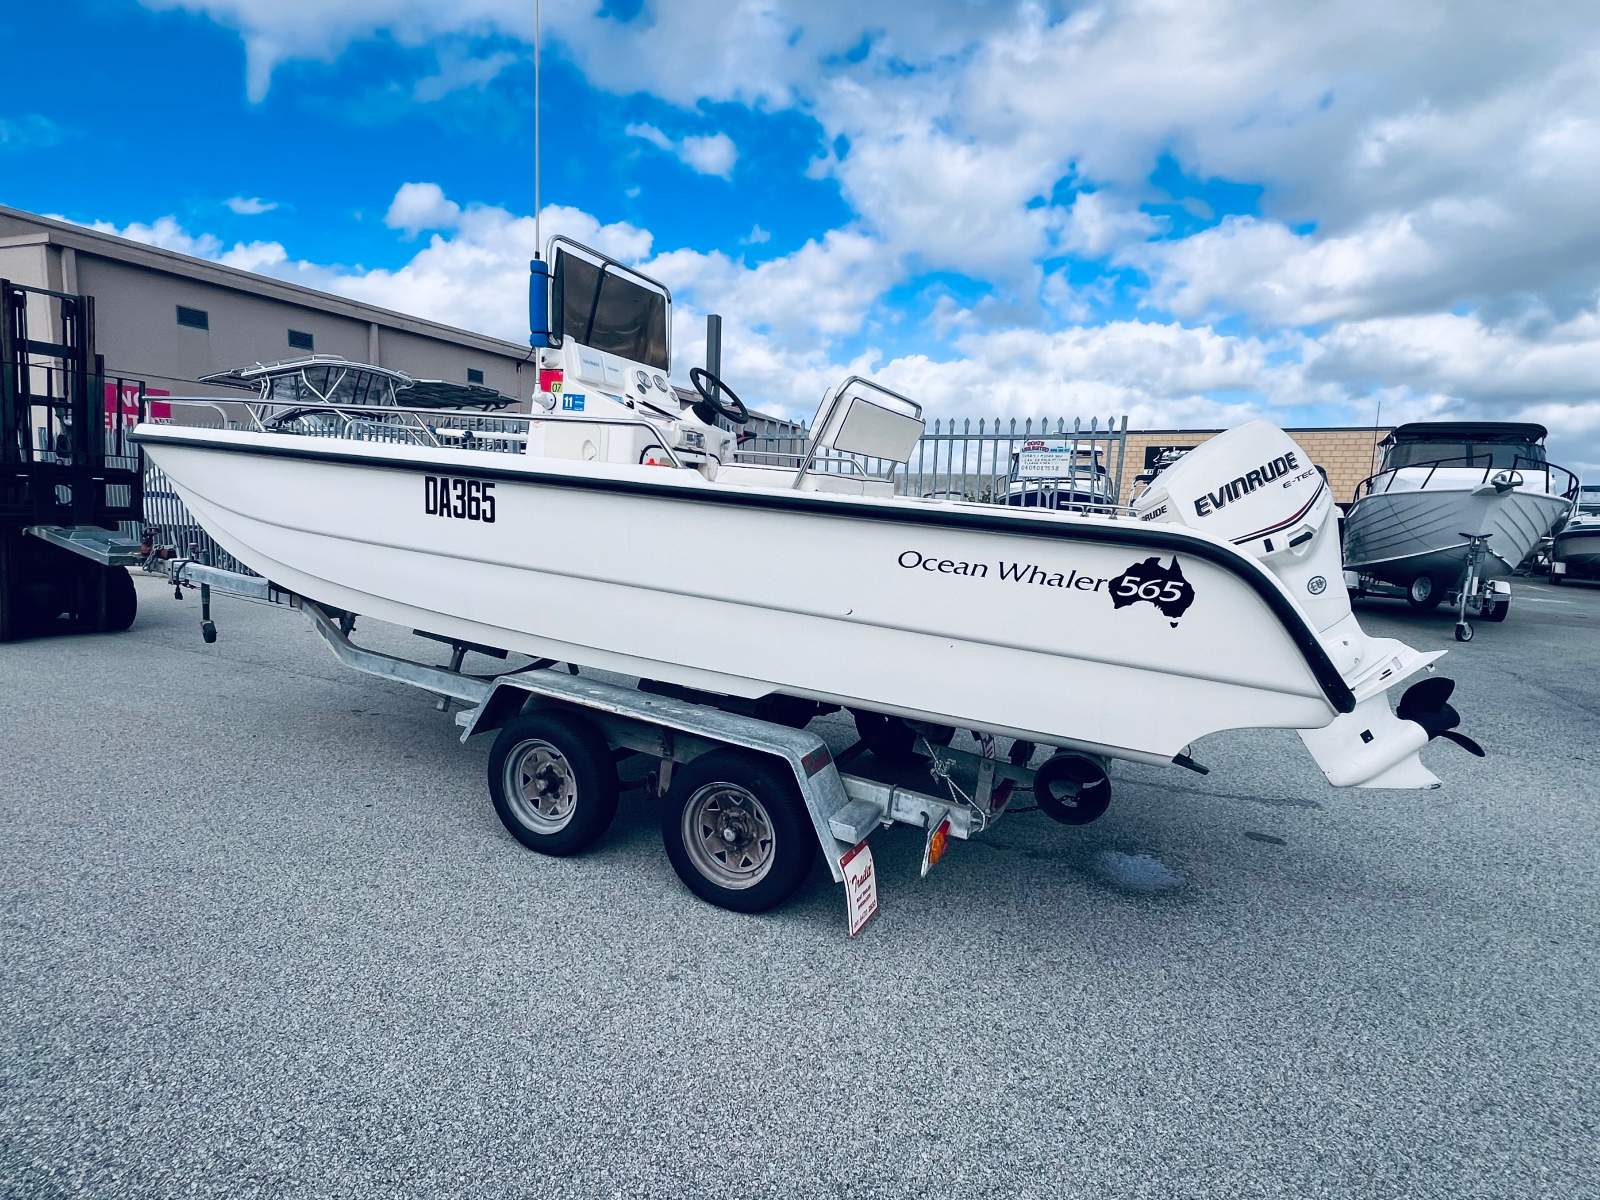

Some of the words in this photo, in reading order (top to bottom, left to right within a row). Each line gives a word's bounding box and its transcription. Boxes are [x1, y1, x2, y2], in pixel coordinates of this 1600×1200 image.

[424, 475, 496, 523] DA365
[1193, 451, 1300, 517] EVINRUDE
[1282, 468, 1316, 489] E-TEC
[897, 550, 988, 578] Ocean
[998, 561, 1108, 592] Whaler
[1117, 576, 1184, 603] 565
